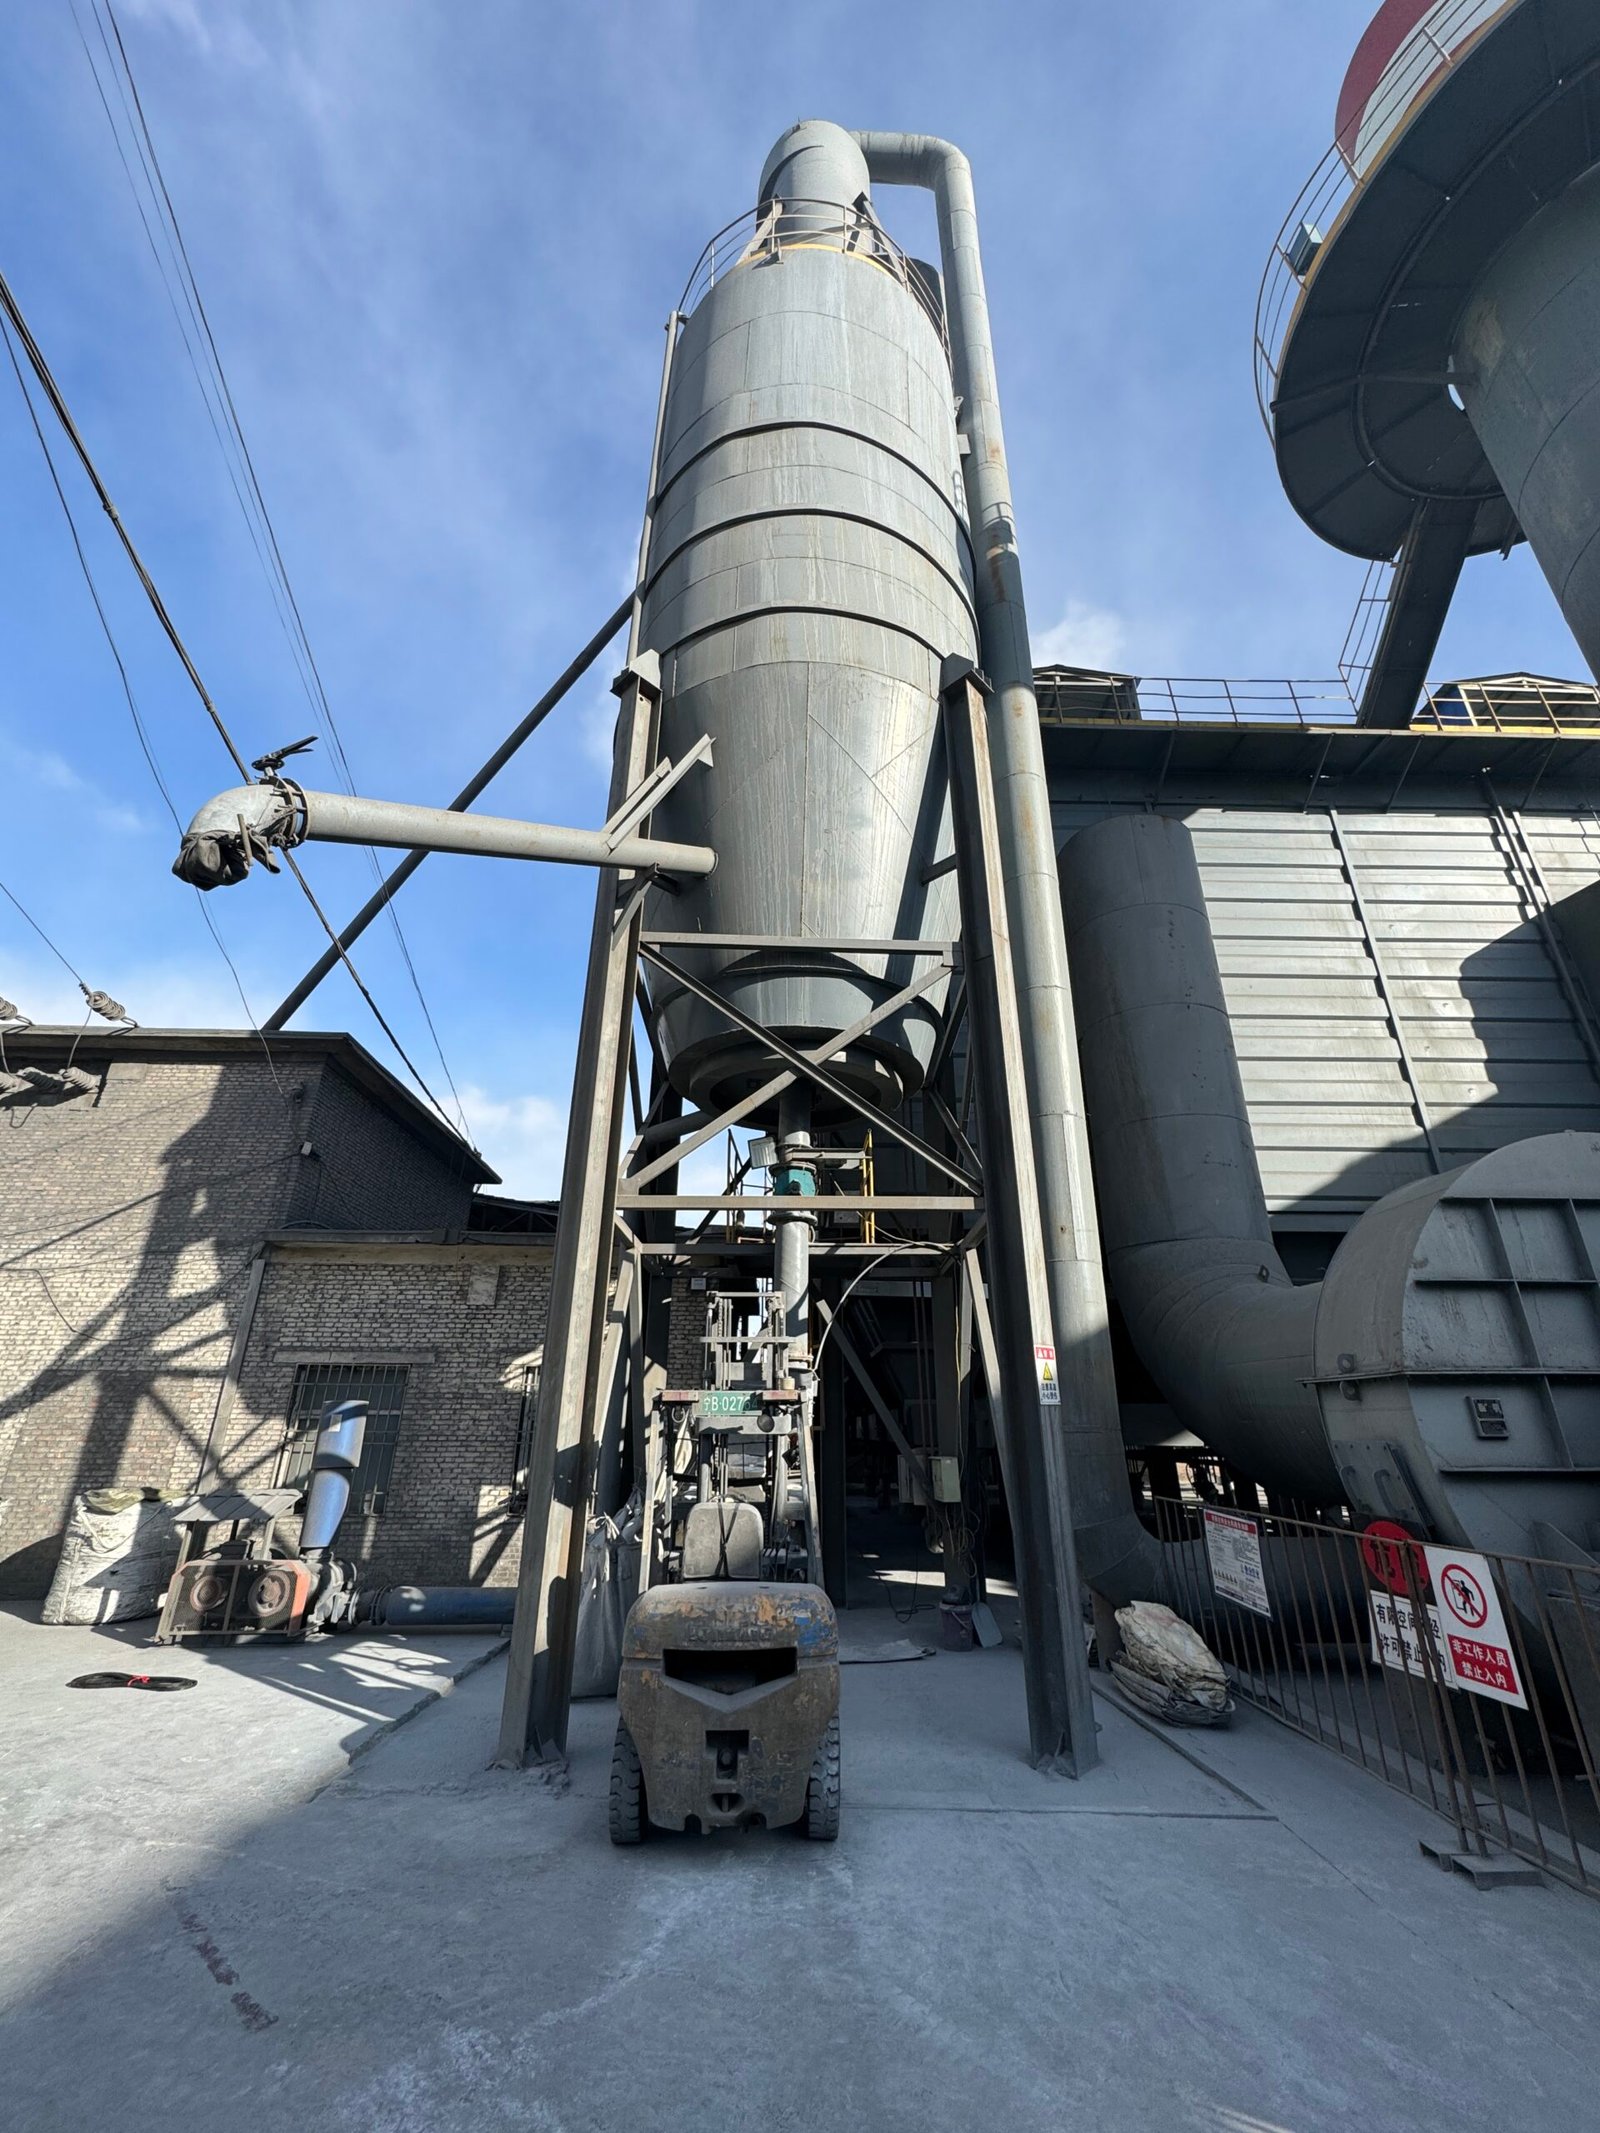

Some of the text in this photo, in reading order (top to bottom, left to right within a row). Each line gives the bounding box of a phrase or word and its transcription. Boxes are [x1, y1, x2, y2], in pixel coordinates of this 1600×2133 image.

[1370, 1531, 1427, 1584] 危
[1379, 1631, 1447, 1673] 许可禁止内
[1451, 1638, 1508, 1668] 非工作人员
[1461, 1661, 1507, 1689] 禁止入内
